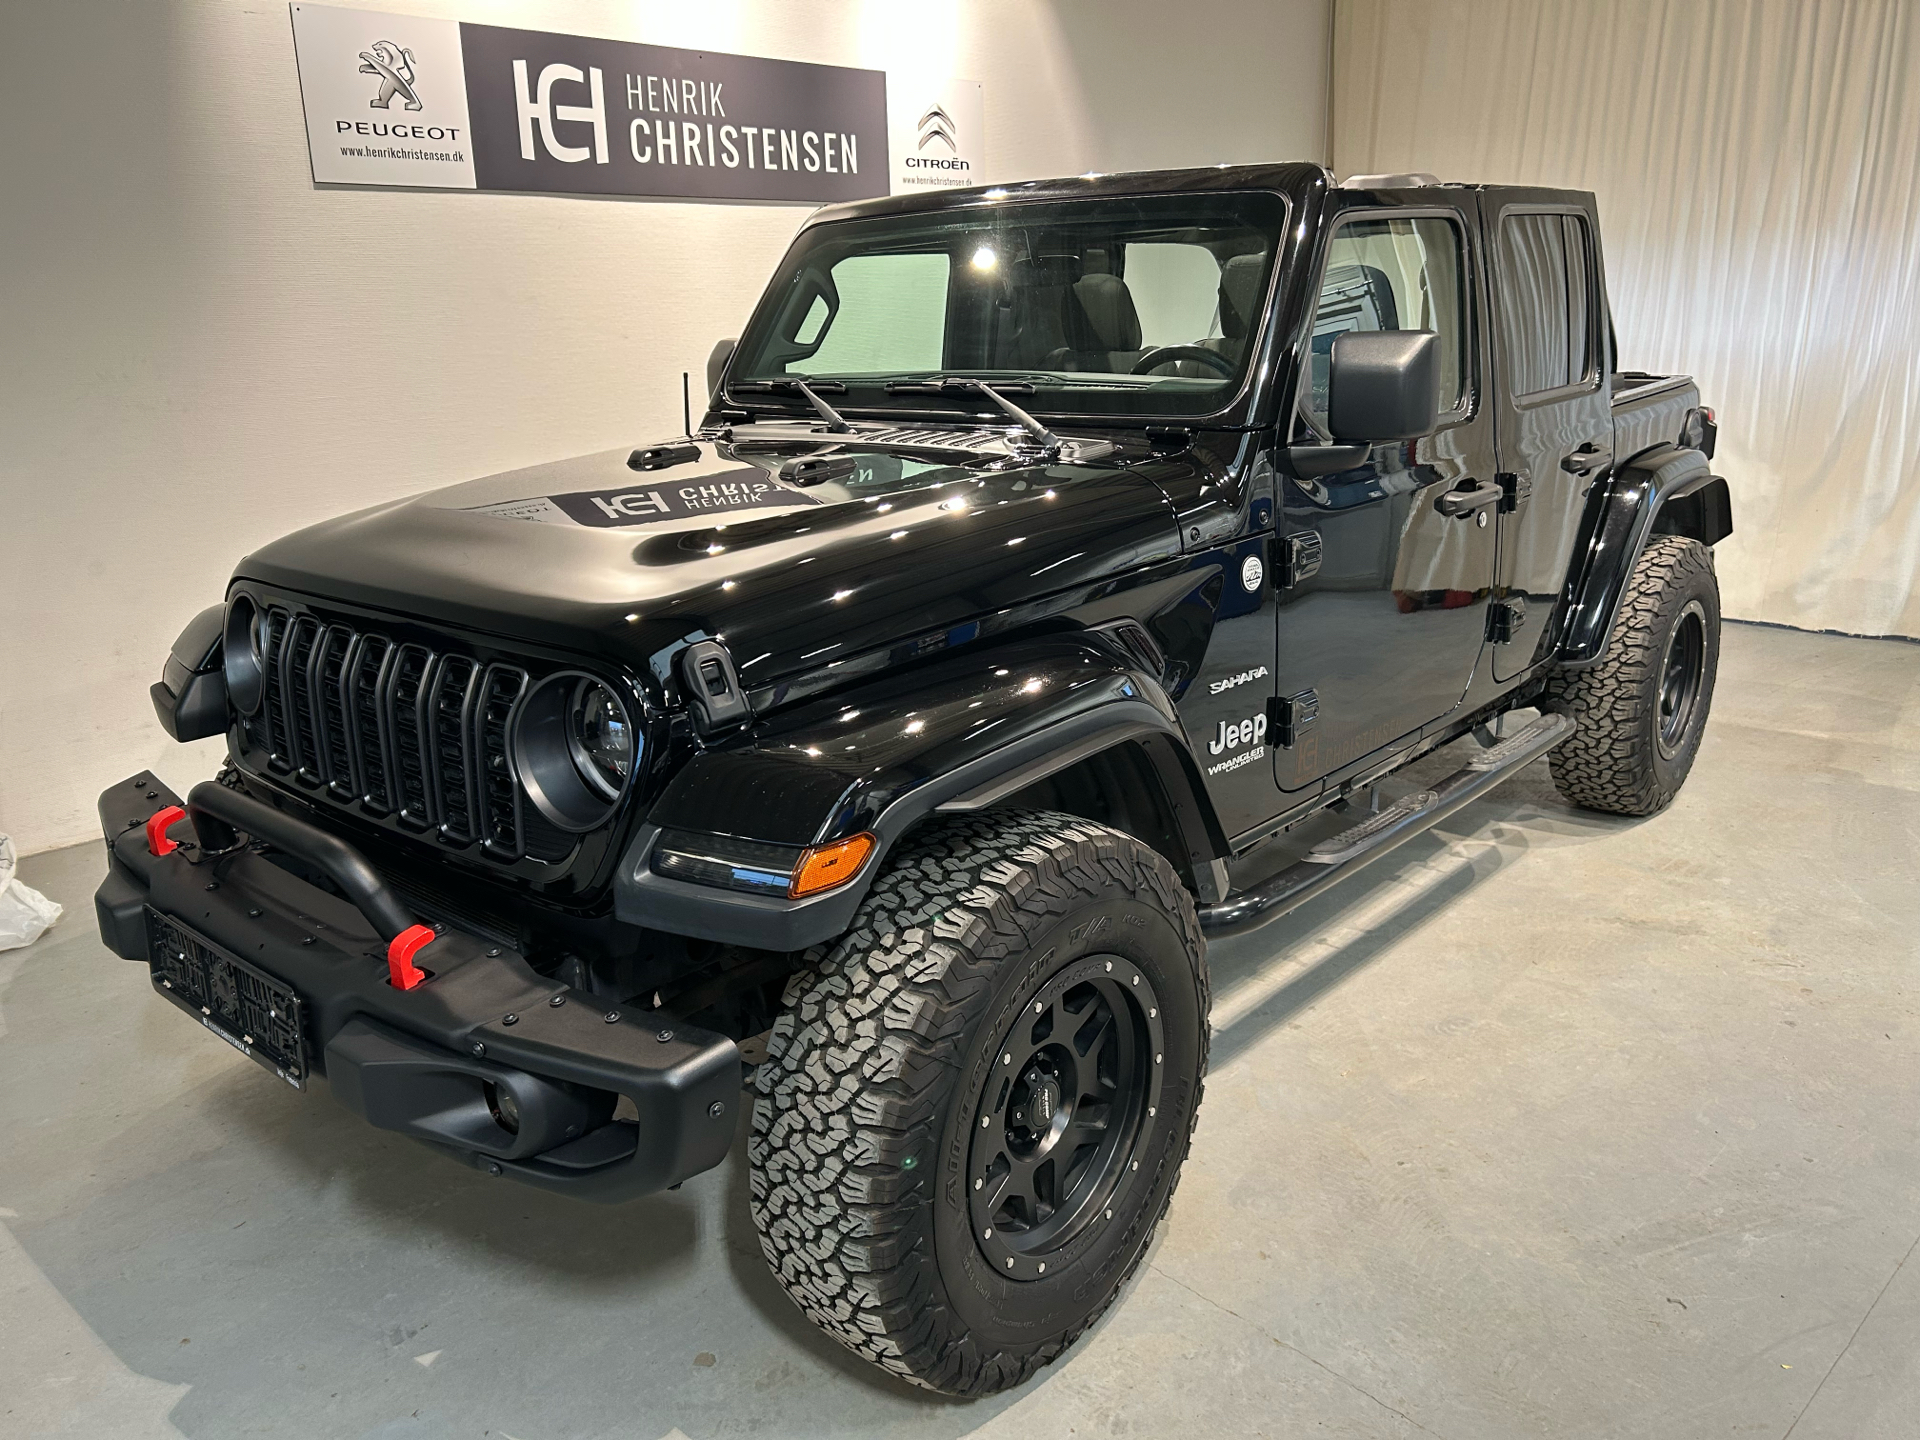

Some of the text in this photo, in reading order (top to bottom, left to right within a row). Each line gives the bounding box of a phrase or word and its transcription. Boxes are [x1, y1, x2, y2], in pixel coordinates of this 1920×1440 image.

[626, 73, 726, 117] HENRIK
[336, 120, 460, 141] PEUGEOT
[340, 145, 464, 163] www.henrikchristensen.dk
[630, 118, 859, 174] CHRISTENSEN
[905, 157, 970, 171] CITROËN
[902, 176, 972, 187] www.henrikchristensen.dk
[1208, 666, 1268, 695] SAHARA
[1207, 712, 1268, 756] Jeep
[1207, 745, 1265, 776] WRANGLER
[1225, 751, 1265, 773] UNLIMITED
